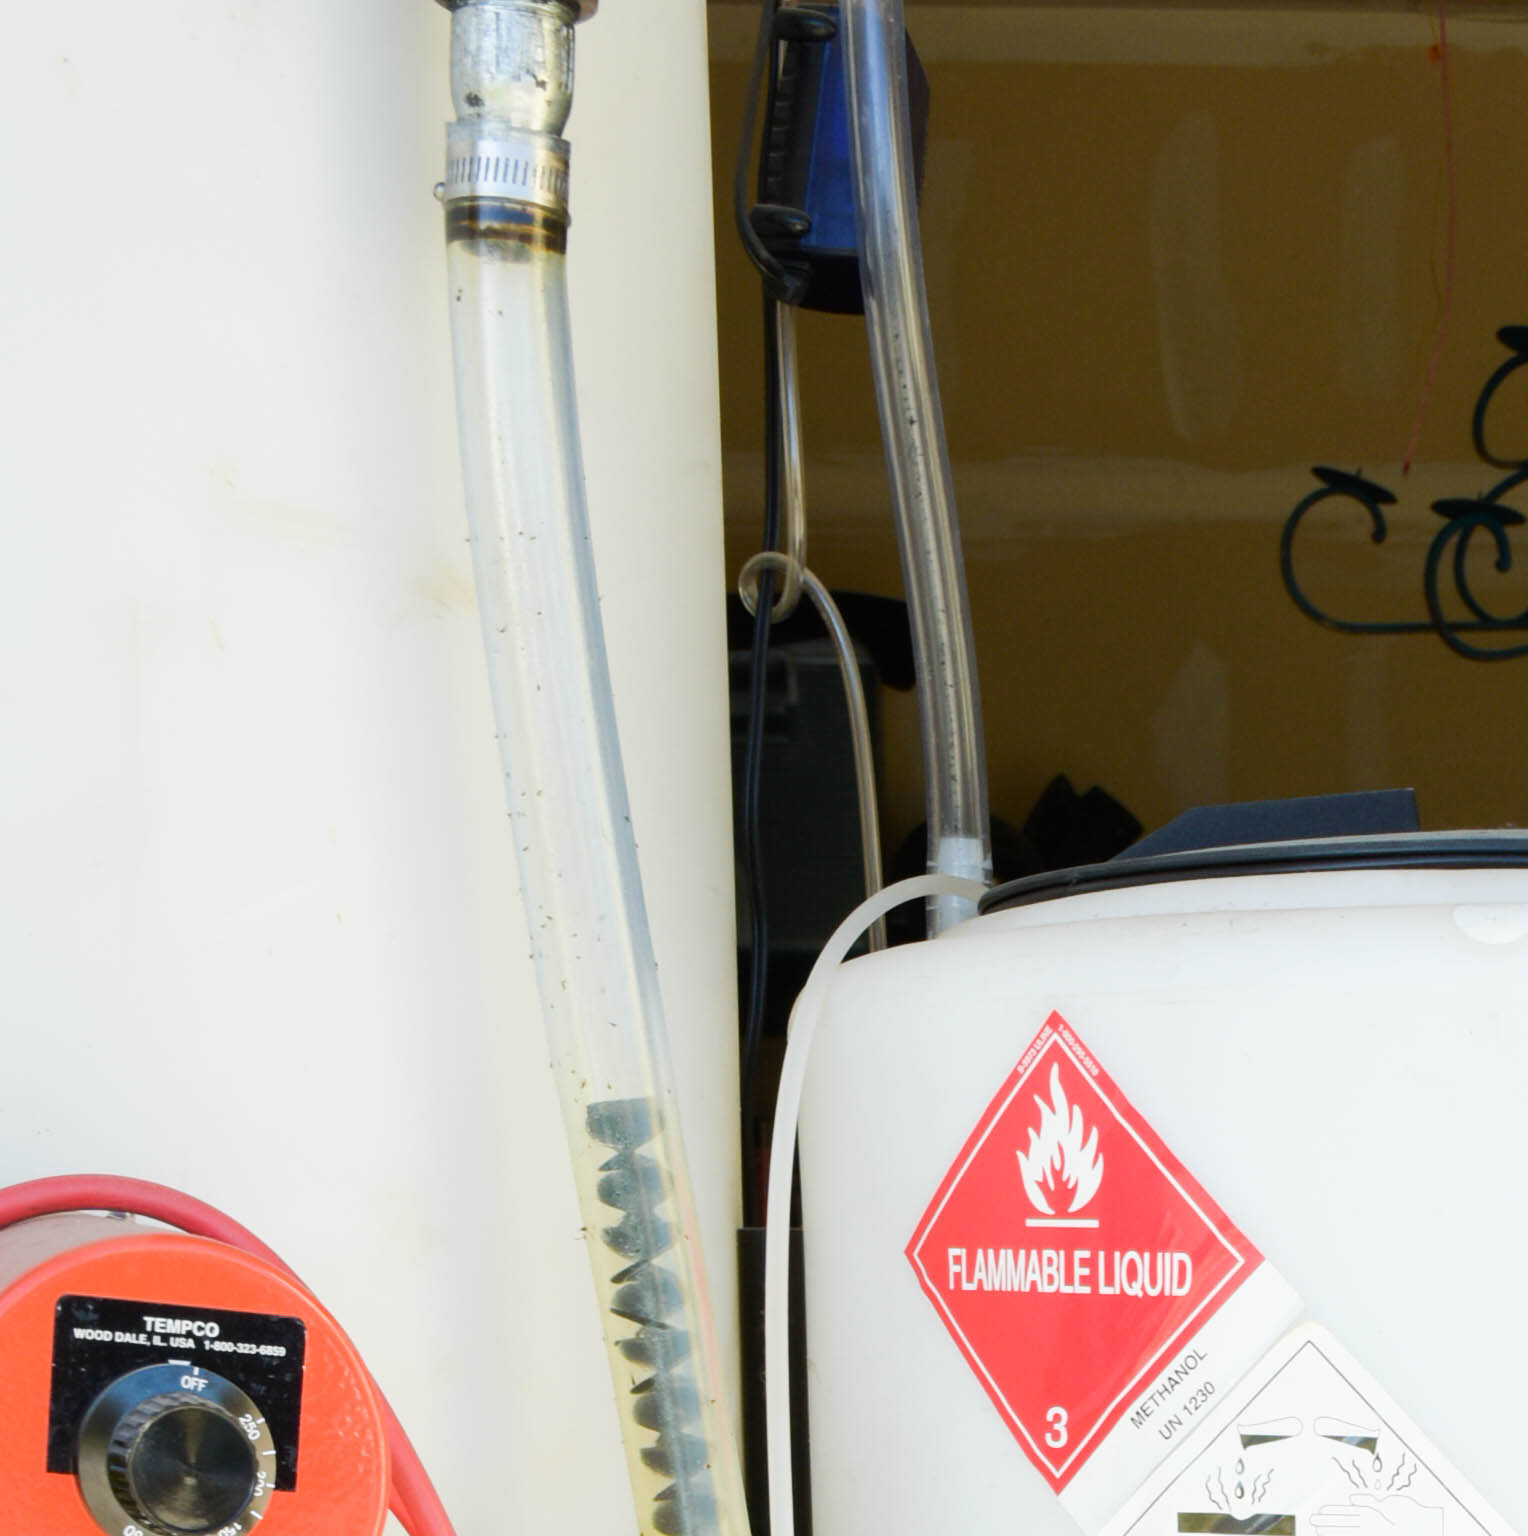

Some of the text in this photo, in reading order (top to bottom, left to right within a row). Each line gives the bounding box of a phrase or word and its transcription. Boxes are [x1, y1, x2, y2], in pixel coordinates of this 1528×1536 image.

[948, 1248, 1192, 1298] FLAMMABLE LIQUID
[73, 1328, 113, 1341] WOOD
[114, 1331, 150, 1346] DALE,
[170, 1337, 195, 1349] USA
[143, 1316, 220, 1337] TEMPCO
[180, 1375, 208, 1391] OFF
[1130, 1349, 1208, 1429] METHANOL
[239, 1413, 261, 1440] 250
[1045, 1406, 1068, 1448] 3
[1158, 1381, 1215, 1440] UN 1230
